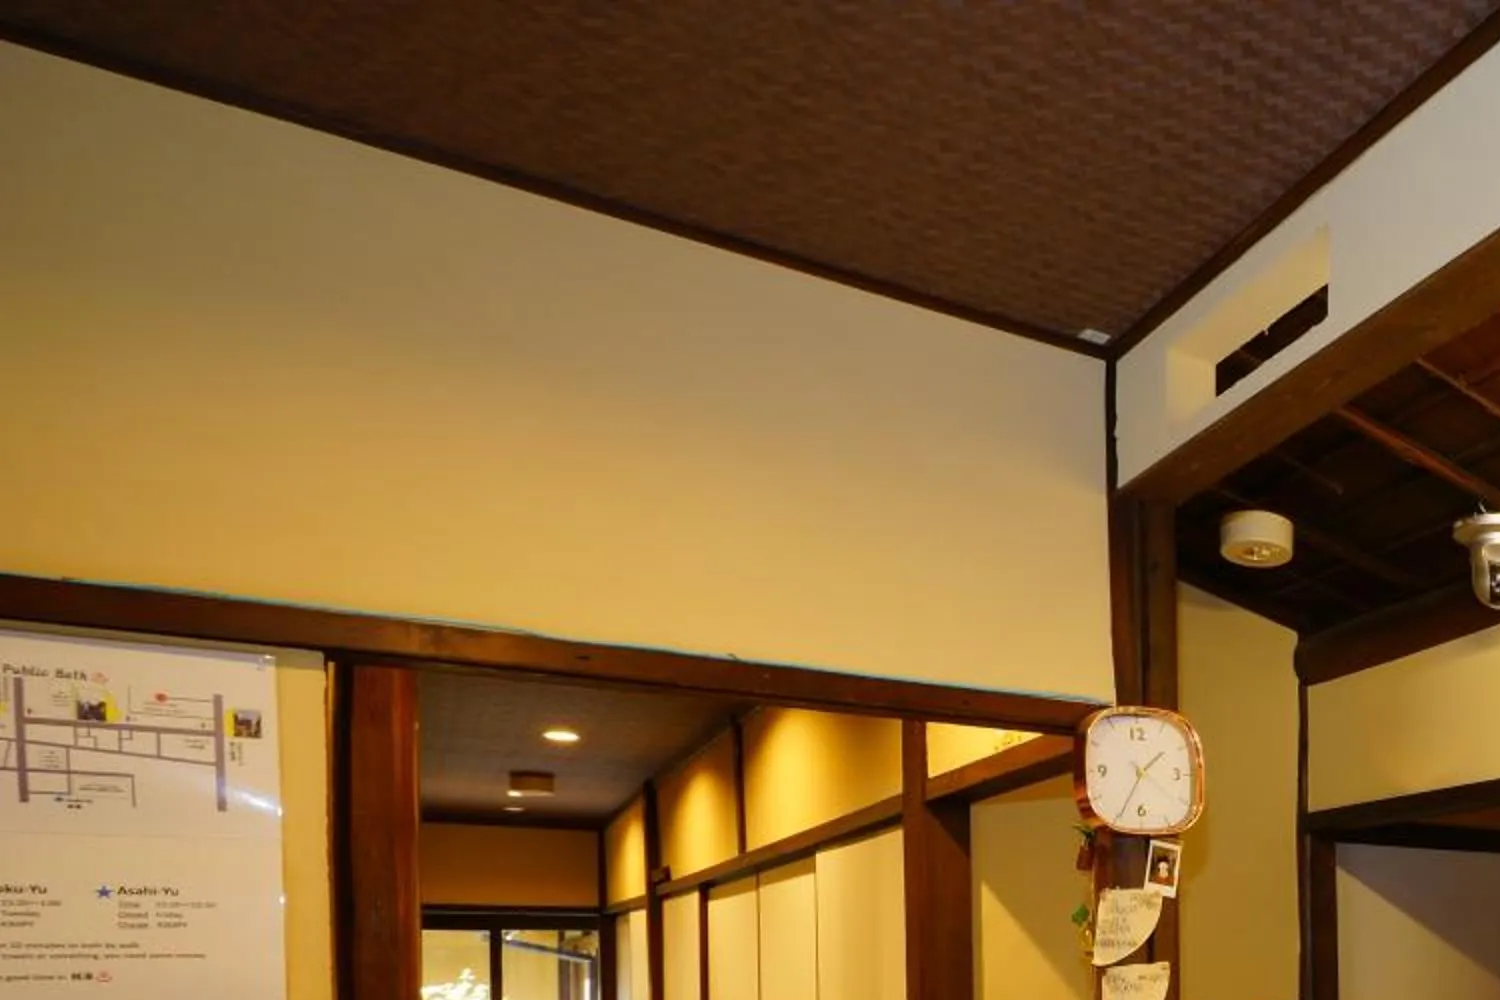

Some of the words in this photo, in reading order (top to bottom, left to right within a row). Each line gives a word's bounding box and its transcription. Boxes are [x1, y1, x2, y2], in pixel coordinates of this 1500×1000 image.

[3, 663, 49, 677] Public
[55, 667, 87, 681] Bath
[1129, 727, 1147, 741] 12
[1097, 764, 1107, 777] 9
[1172, 767, 1182, 781] 3
[1137, 803, 1147, 817] 6
